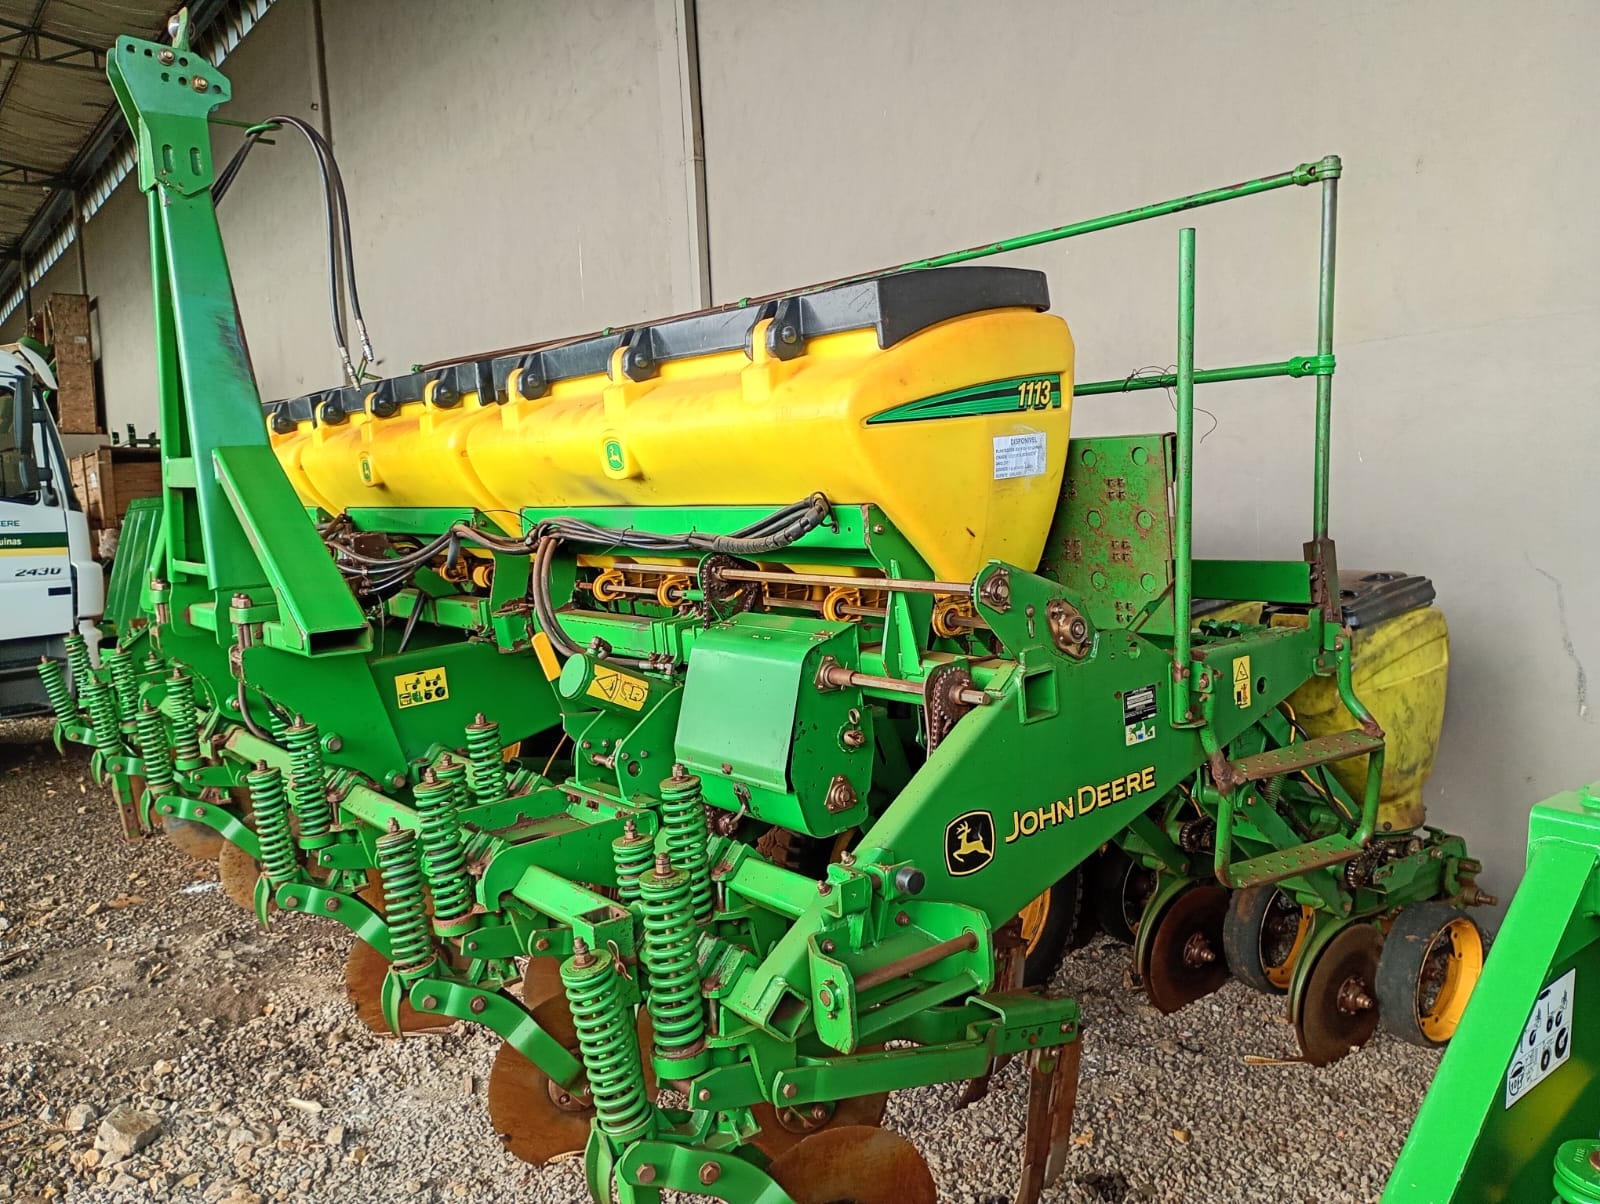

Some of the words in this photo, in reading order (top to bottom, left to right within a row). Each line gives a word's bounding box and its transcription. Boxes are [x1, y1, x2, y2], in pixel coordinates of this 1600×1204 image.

[1018, 380, 1051, 407] 1113
[1005, 796, 1075, 843] JOHN
[1077, 766, 1156, 815] DEERE
